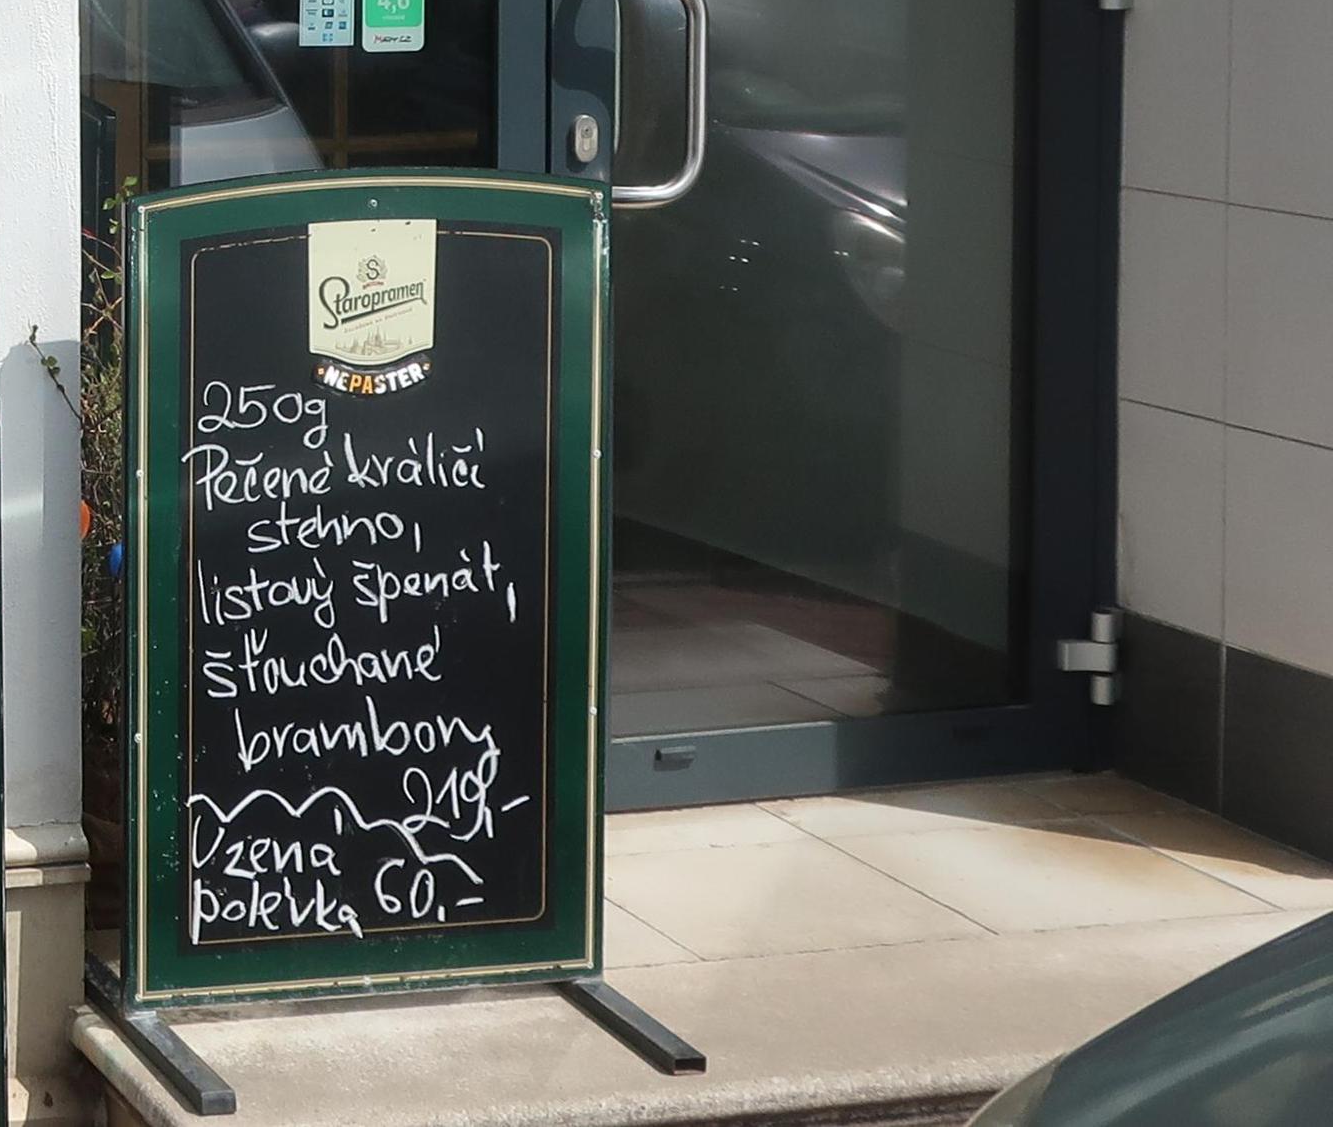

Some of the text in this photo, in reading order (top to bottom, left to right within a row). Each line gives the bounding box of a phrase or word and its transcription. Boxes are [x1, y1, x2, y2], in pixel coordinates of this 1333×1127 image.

[319, 276, 428, 330] Staropramen
[323, 362, 425, 395] NEPASTER
[197, 380, 328, 448] 250g
[181, 427, 486, 511] Pečené králičí
[247, 501, 422, 553] stehno,
[198, 540, 516, 628] listový špenát,
[234, 695, 500, 788] brambory
[192, 805, 342, 878] Uzená
